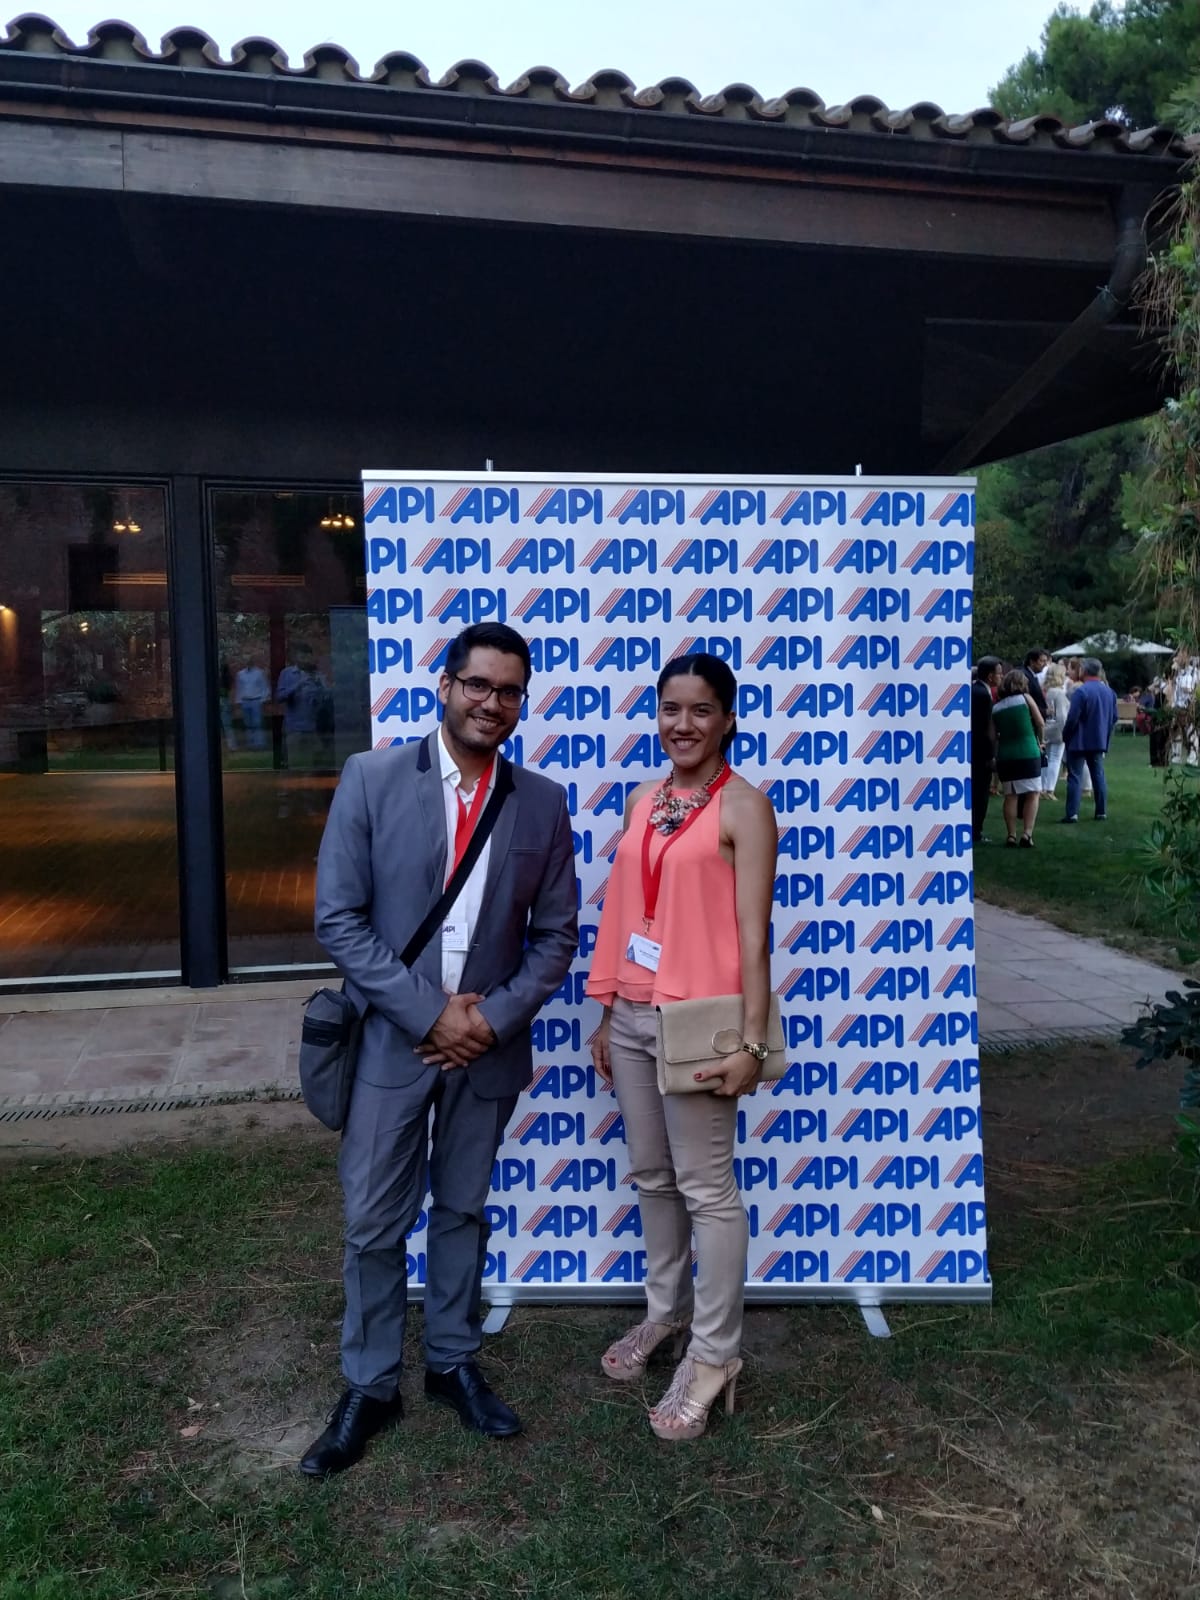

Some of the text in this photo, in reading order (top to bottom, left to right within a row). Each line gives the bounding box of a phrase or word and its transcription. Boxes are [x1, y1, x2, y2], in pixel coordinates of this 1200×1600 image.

[365, 487, 434, 523] API
[451, 488, 519, 524] API
[535, 489, 603, 524] API
[618, 490, 685, 525] API
[700, 490, 766, 525] API
[781, 491, 846, 526] API
[861, 492, 925, 527] API
[366, 538, 974, 575] PI API API API API API API API
[439, 588, 507, 623] API
[522, 588, 590, 623] API
[605, 588, 671, 623] API
[687, 588, 752, 623] API
[767, 587, 833, 622] API
[848, 587, 910, 622] API
[594, 637, 660, 672] API
[756, 636, 822, 671] API
[837, 635, 900, 670] API
[544, 686, 610, 721] API
[734, 684, 772, 719] PI
[787, 683, 853, 718] API
[868, 683, 928, 717] API
[539, 734, 606, 769] API
[782, 731, 848, 766] API
[863, 730, 923, 765] API
[835, 778, 900, 812] API
[913, 777, 971, 811] API
[776, 826, 835, 860] API
[850, 825, 913, 860] API
[839, 872, 904, 907] API
[789, 920, 855, 955] API
[870, 919, 933, 954] API
[784, 967, 850, 1002] API
[865, 966, 929, 1001] API
[837, 1014, 904, 1048] API
[918, 1012, 978, 1047] API
[530, 1065, 596, 1099] API
[772, 1061, 837, 1096] API
[852, 1061, 919, 1095] API
[519, 1112, 585, 1146] API
[761, 1109, 827, 1144] API
[842, 1108, 908, 1143] API
[550, 1158, 616, 1192] API
[792, 1156, 858, 1190] API
[873, 1155, 940, 1190] API
[484, 1204, 517, 1238] PI
[532, 1205, 597, 1238] API
[774, 1203, 840, 1238] API
[855, 1203, 921, 1237] API
[521, 1250, 587, 1283] API
[763, 1250, 829, 1283] API
[844, 1250, 910, 1283] API
